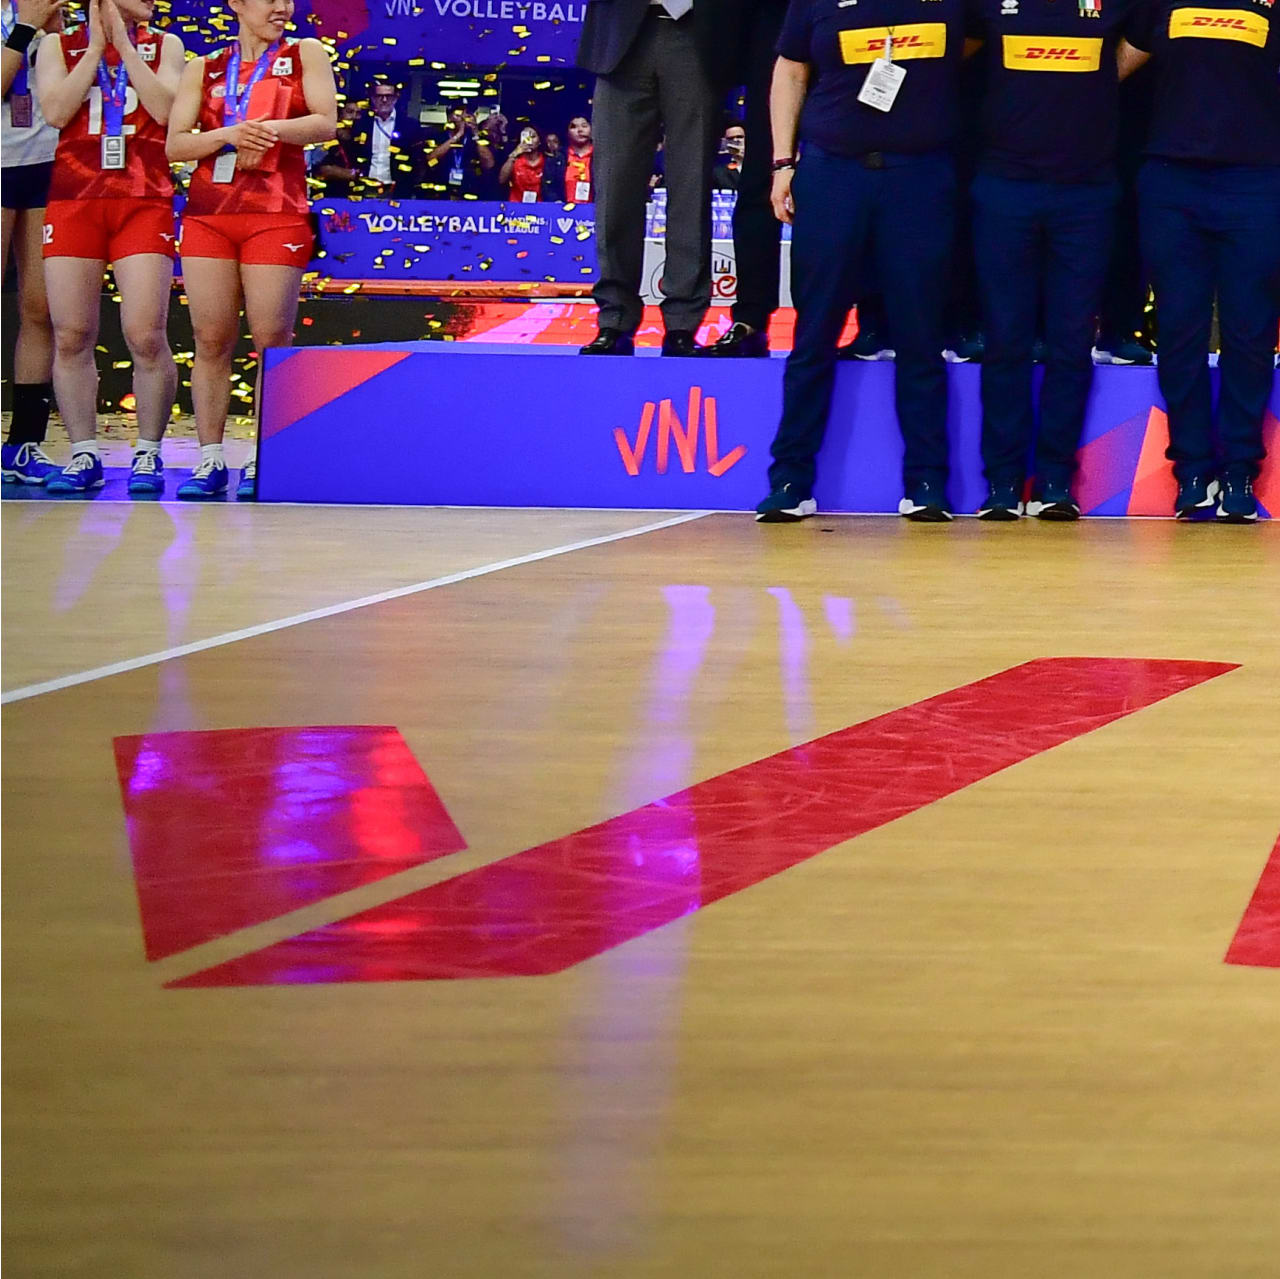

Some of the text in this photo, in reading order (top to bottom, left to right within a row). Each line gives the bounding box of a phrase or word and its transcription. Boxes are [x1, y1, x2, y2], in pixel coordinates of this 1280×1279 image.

[1079, 9, 1100, 19] ITA
[1192, 16, 1250, 30] DHL
[867, 35, 924, 52] DHL
[1025, 47, 1081, 60] DHL
[363, 214, 501, 233] VOLLEYBALL
[612, 386, 748, 477] VNL
